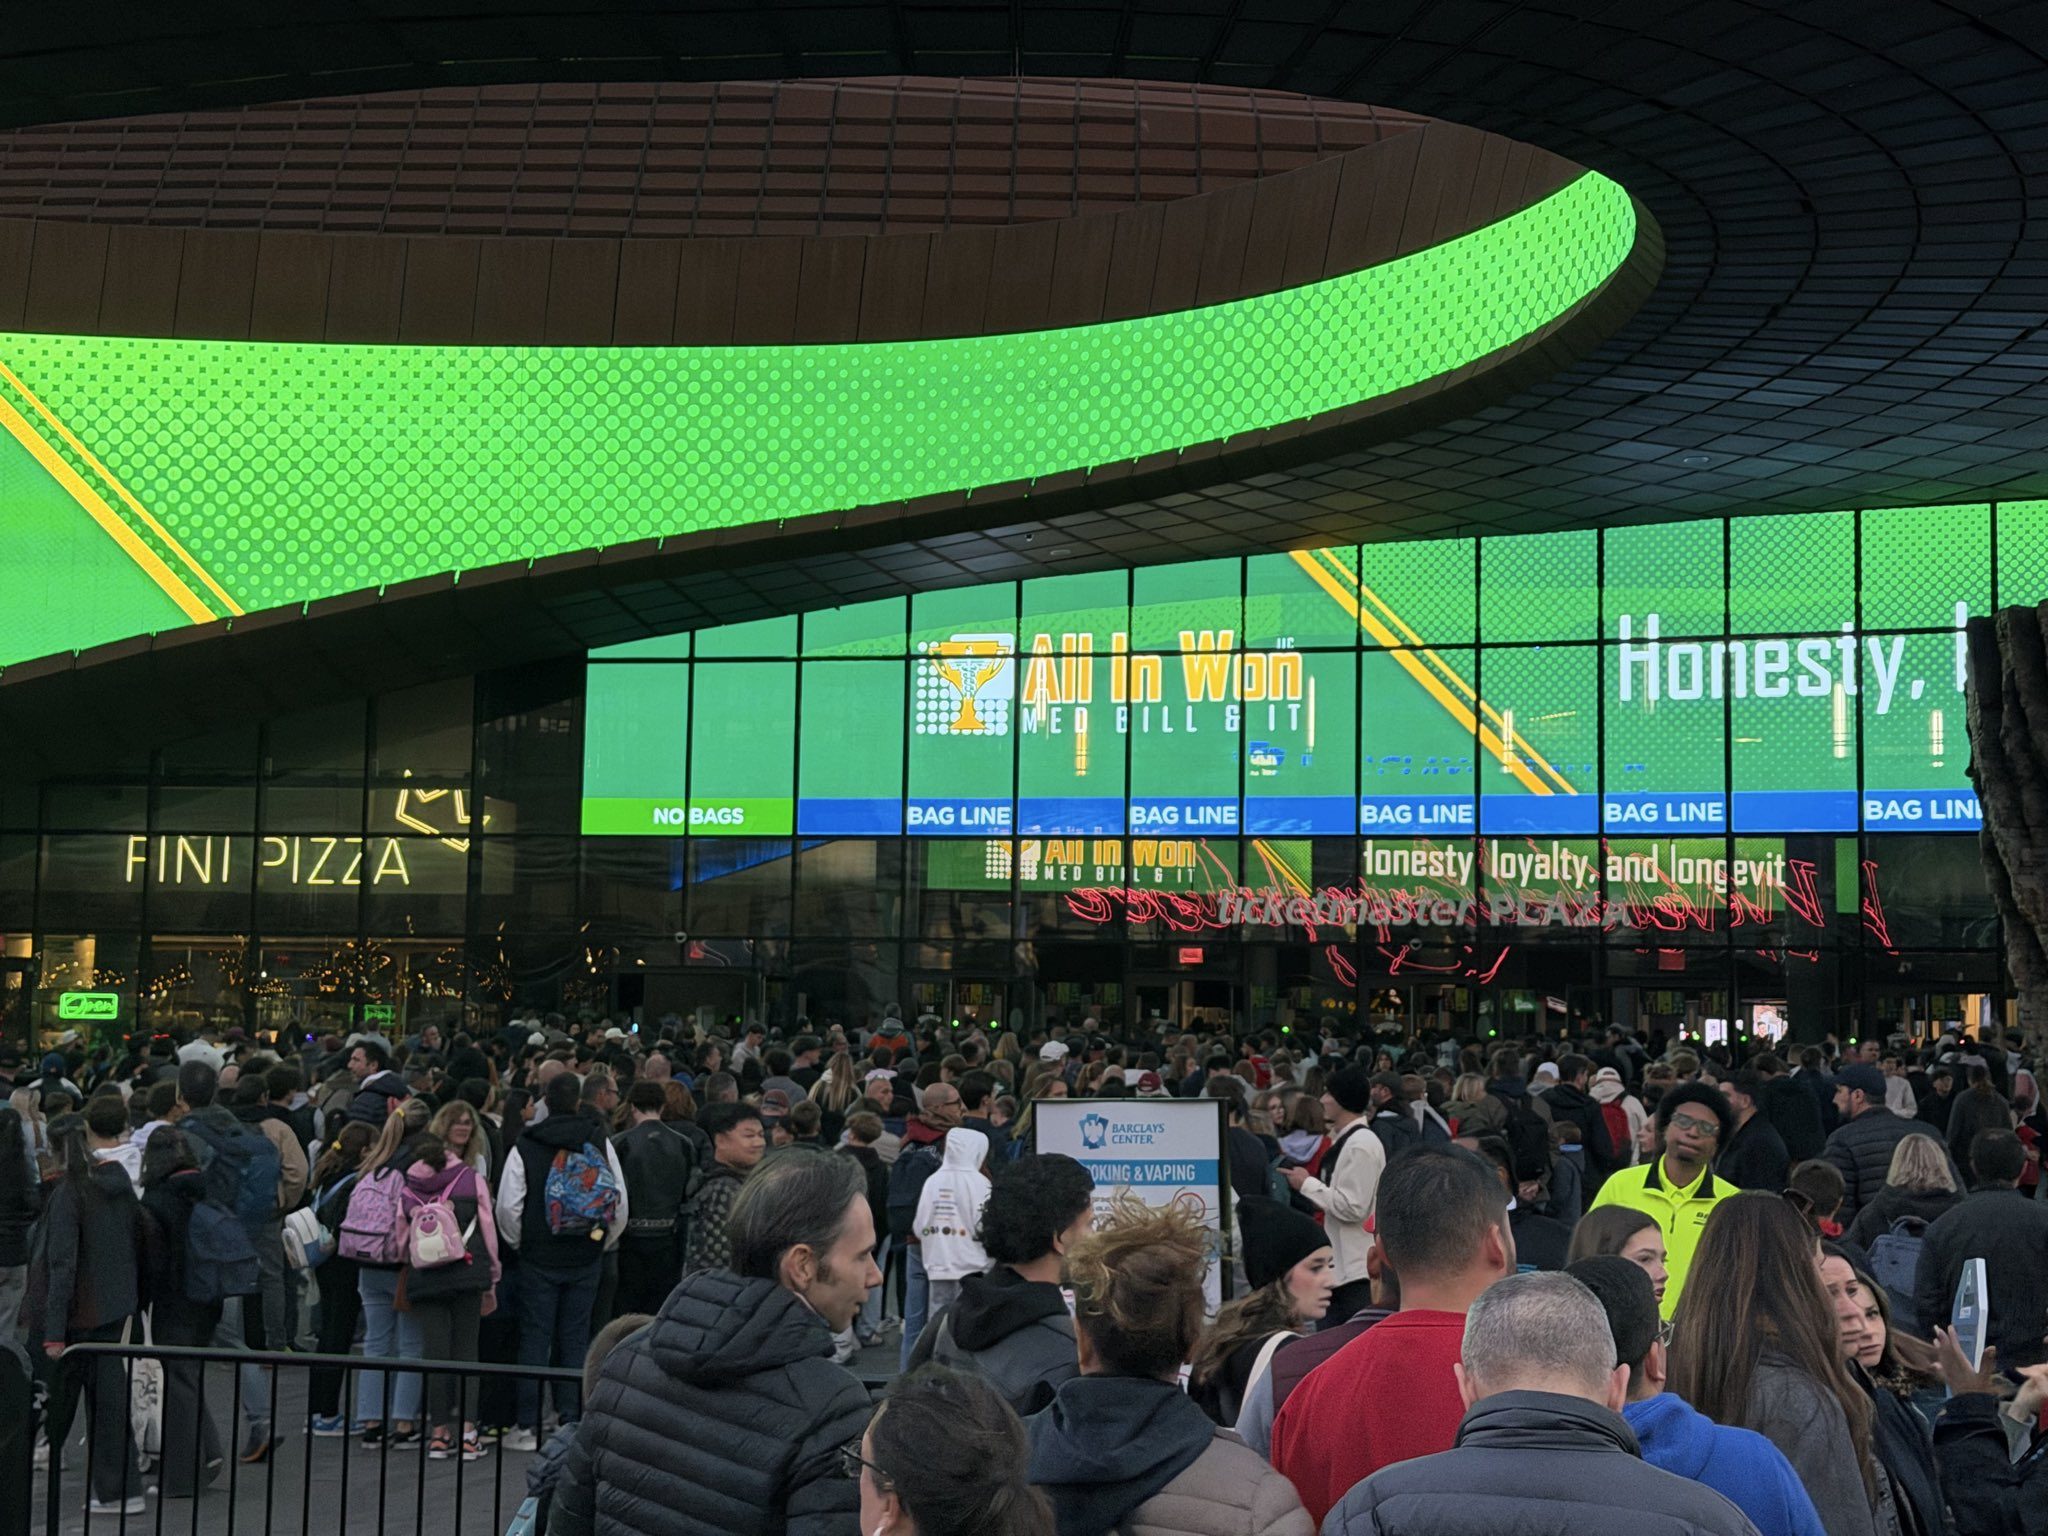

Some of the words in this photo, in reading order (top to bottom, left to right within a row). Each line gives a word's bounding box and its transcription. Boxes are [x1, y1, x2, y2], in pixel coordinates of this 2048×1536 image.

[1022, 633, 1093, 704] All
[1110, 632, 1162, 703] In
[1179, 630, 1303, 702] Won
[1619, 612, 1926, 715] Honesty,
[1022, 706, 1088, 734] MED
[1116, 705, 1198, 733] BILL
[1225, 704, 1240, 733] &
[1268, 703, 1301, 732] IT
[653, 807, 685, 825] NO
[688, 807, 744, 825] BAGS
[908, 806, 955, 826] BAG
[961, 806, 1010, 826] LINE
[1130, 805, 1178, 825] BAG
[1184, 805, 1237, 825] LINE
[1361, 804, 1412, 824] BAG
[1419, 804, 1473, 823] LINE
[1605, 802, 1658, 823] BAG
[1666, 802, 1723, 822] LINE
[1866, 800, 1922, 820] BAG
[126, 836, 230, 883] FINI
[262, 836, 409, 884] PIZZA
[1044, 840, 1084, 865] All
[1093, 840, 1122, 866] In
[1132, 840, 1196, 867] Won
[1044, 865, 1082, 881] MED
[1154, 867, 1163, 883] &
[1492, 839, 1596, 889] loyalty,
[1606, 844, 1659, 883] and
[1490, 893, 1631, 926] PLAZA
[1112, 1123, 1165, 1134] BARCLAYS
[1112, 1134, 1154, 1145] CENTER
[1088, 1164, 1131, 1181] OKING
[1134, 1166, 1143, 1181] &
[1144, 1164, 1196, 1181] VAPING
